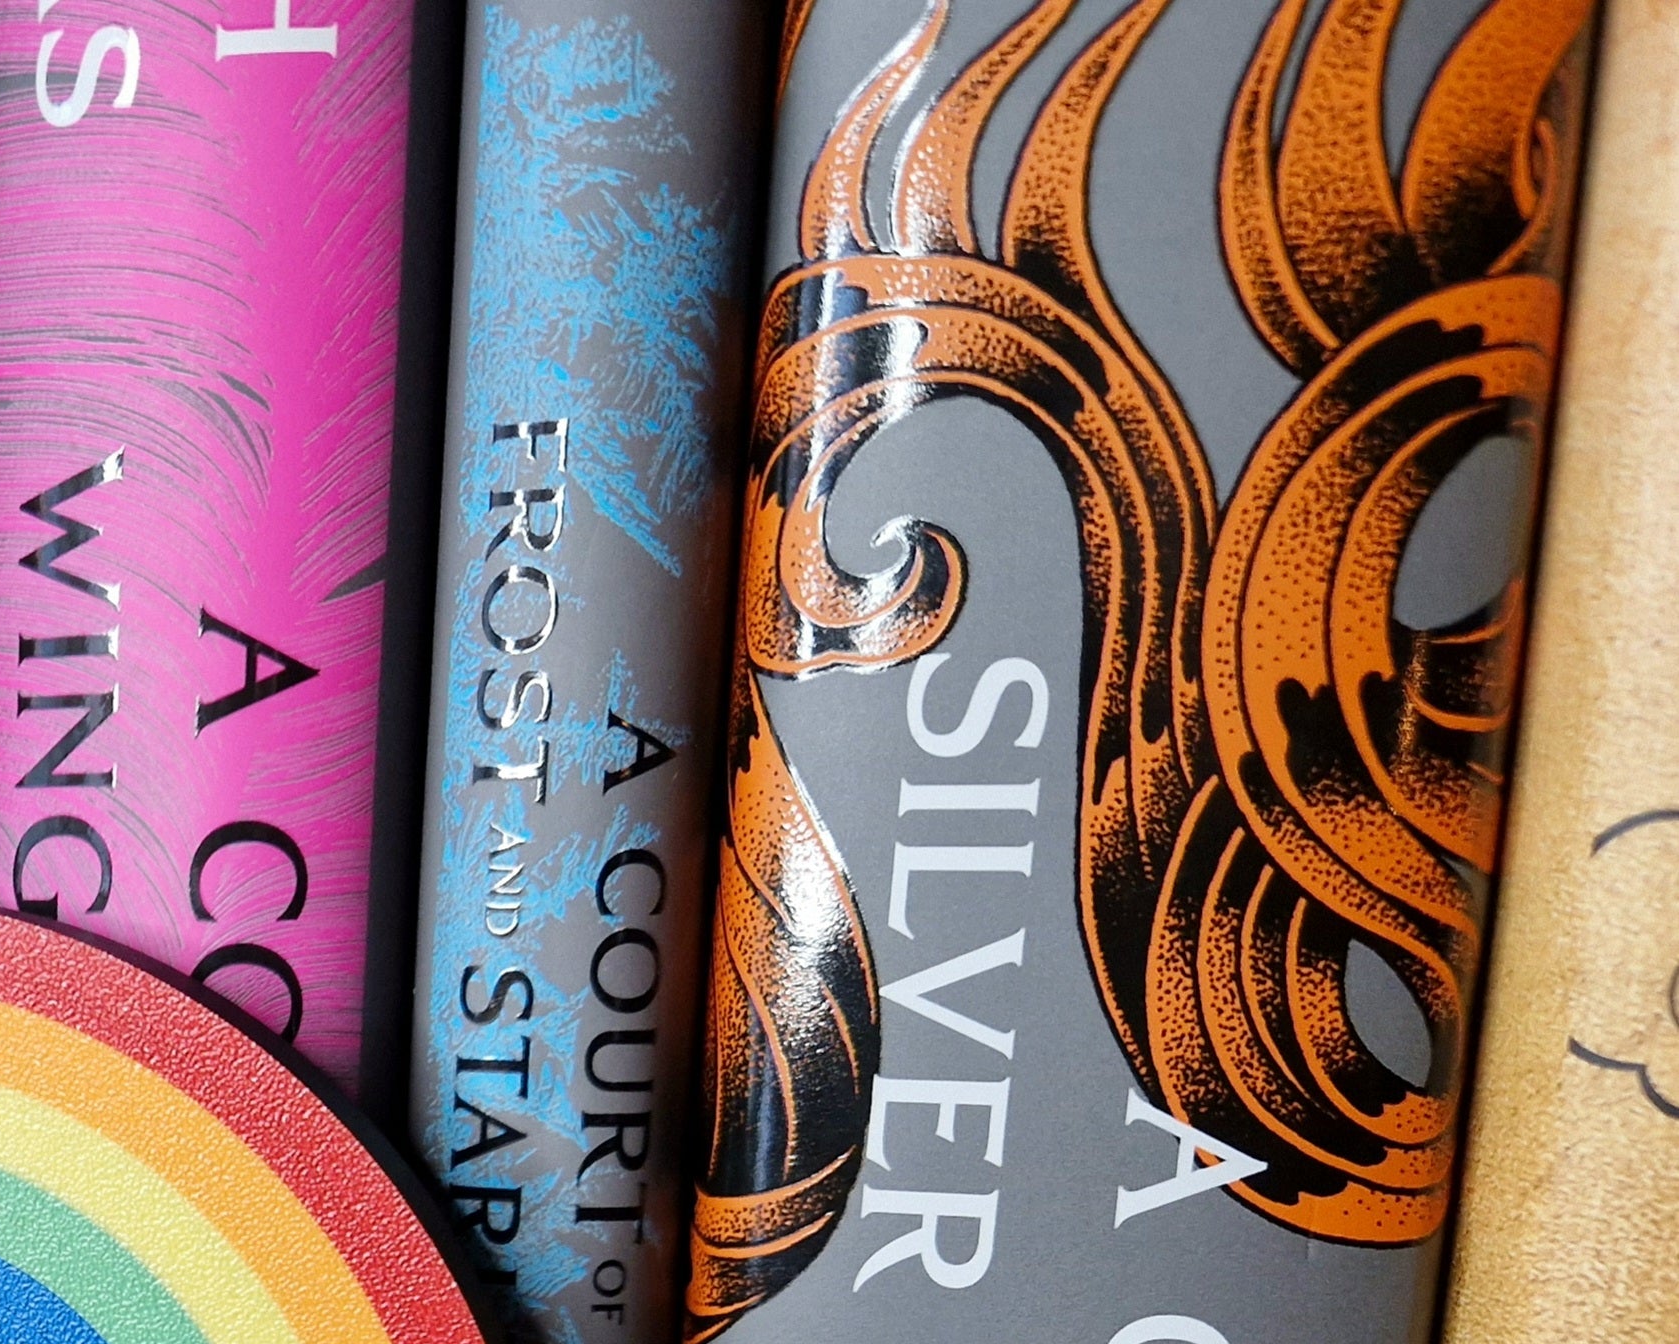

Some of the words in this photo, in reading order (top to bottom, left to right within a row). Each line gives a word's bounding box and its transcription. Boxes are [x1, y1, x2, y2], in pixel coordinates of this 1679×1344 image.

[12, 444, 125, 920] WING
[194, 605, 320, 738] A
[472, 417, 569, 806] FROST
[602, 707, 677, 797] A
[485, 823, 527, 937] AND
[853, 652, 1049, 1293] SILVER
[575, 848, 667, 1244] COURT
[1114, 1087, 1268, 1230] A
[591, 1259, 626, 1326] OF
